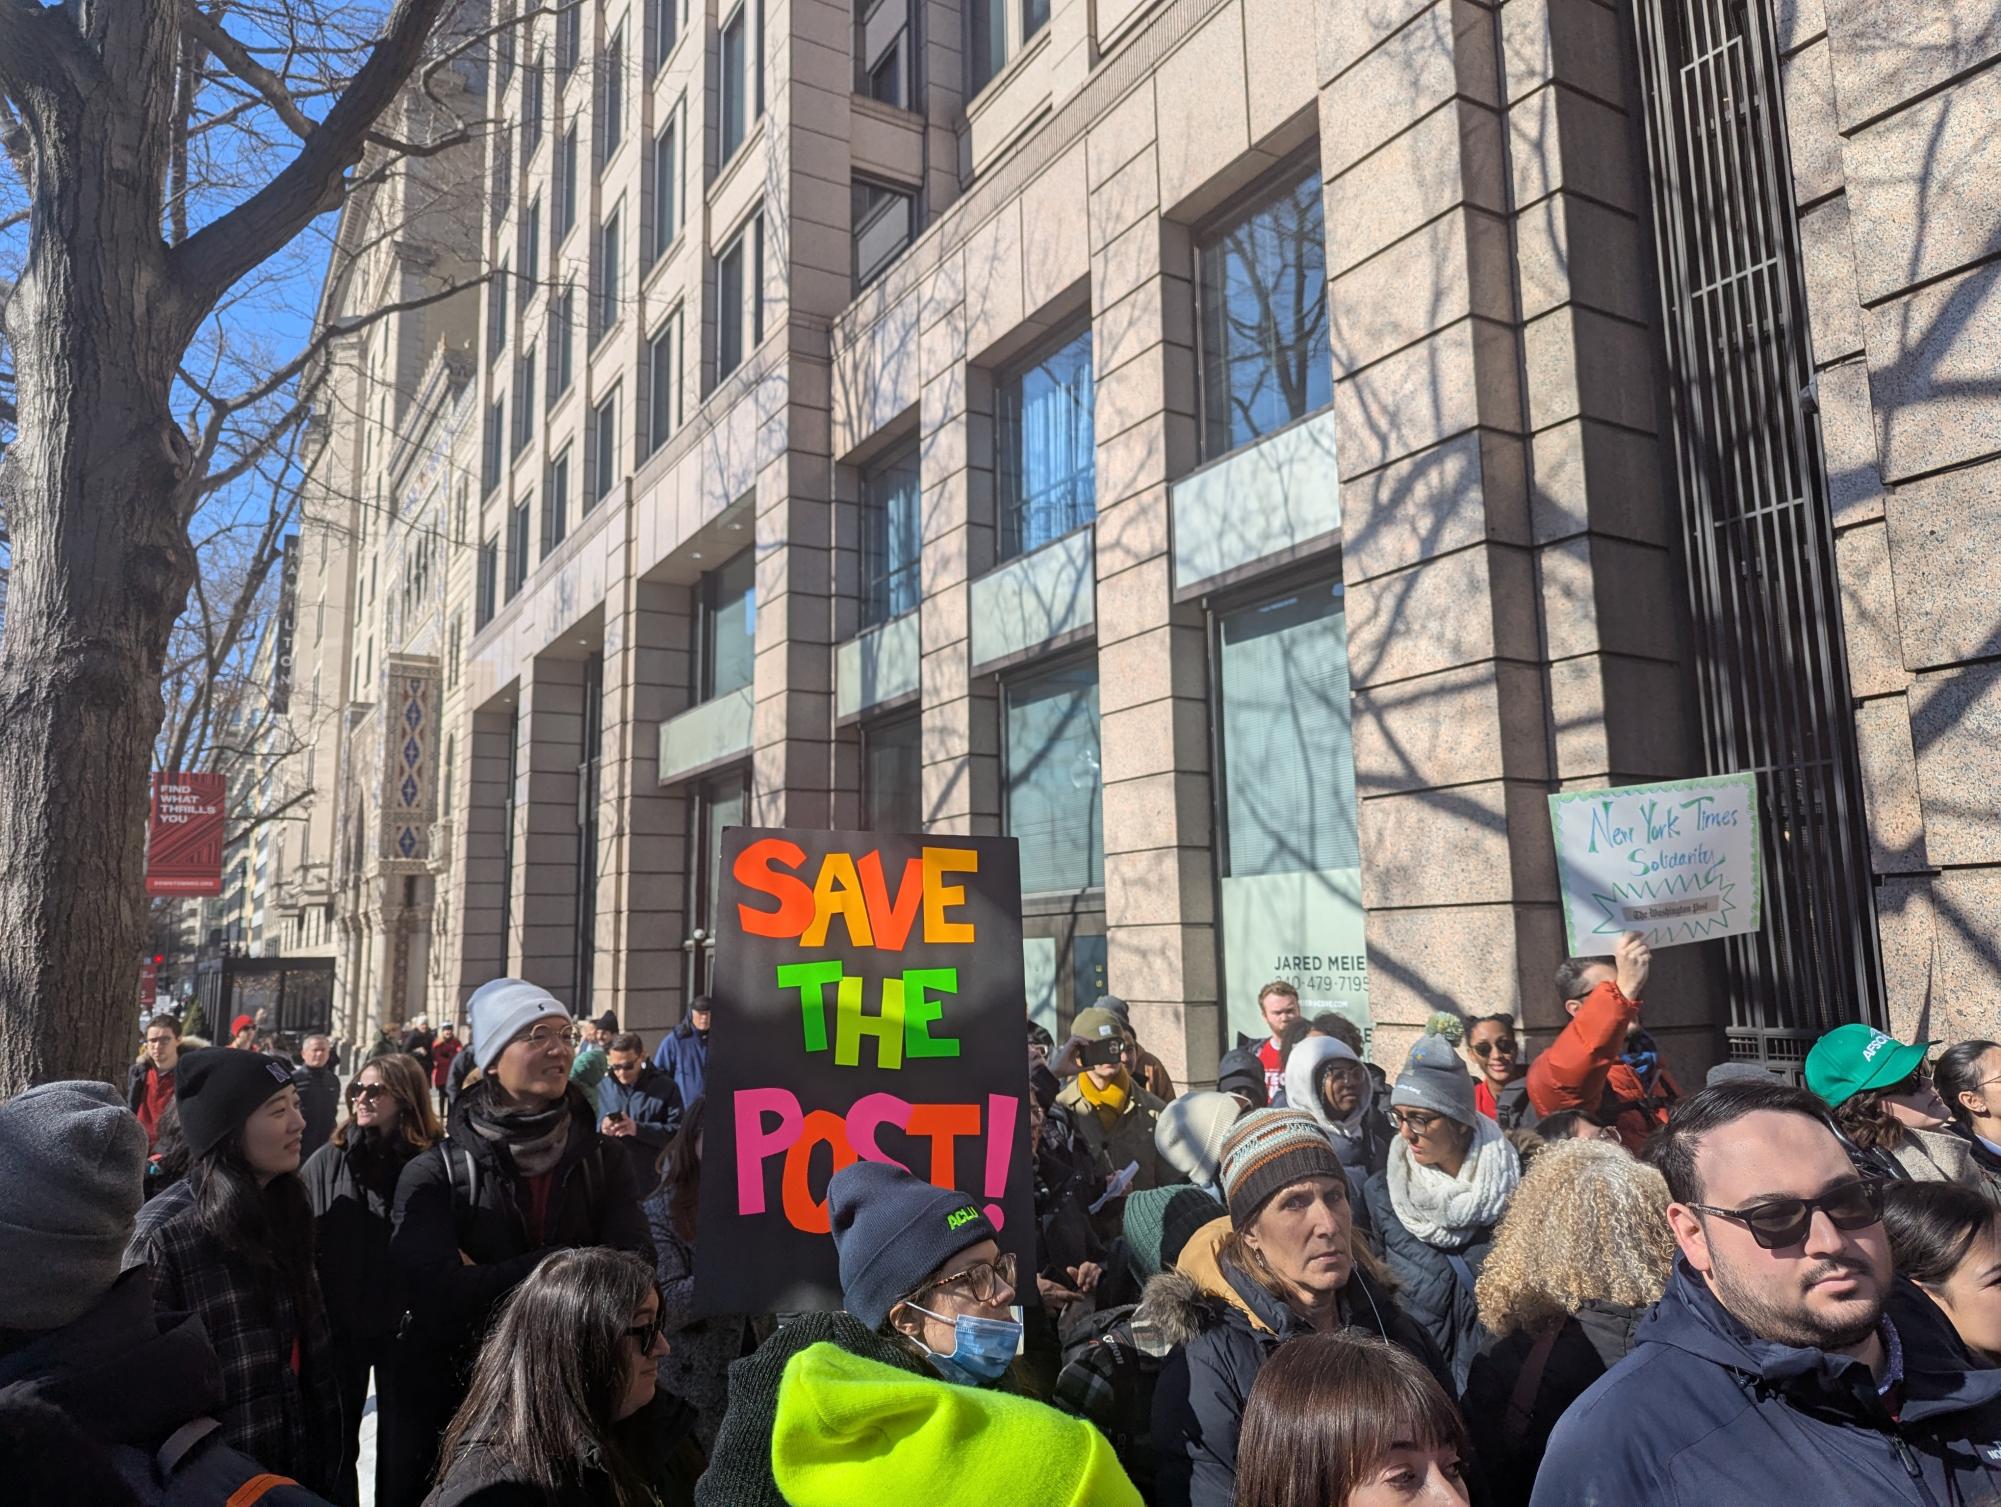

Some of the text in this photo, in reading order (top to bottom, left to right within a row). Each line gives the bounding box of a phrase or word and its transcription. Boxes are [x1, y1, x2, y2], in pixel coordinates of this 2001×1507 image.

[280, 547, 299, 685] HAMILTON
[160, 785, 191, 794] FIND
[160, 795, 200, 804] WHAT
[160, 804, 217, 815] THRILLS
[160, 815, 188, 824] YOU
[1588, 796, 1738, 853] New York Times
[1627, 843, 1725, 884] Solidarity
[733, 838, 978, 951] SAVE
[1632, 902, 1708, 921] The Washington Post
[1274, 956, 1322, 971] JARED
[776, 960, 960, 1069] THE
[734, 1088, 1018, 1234] POST!
[947, 1206, 979, 1231] ACLU
